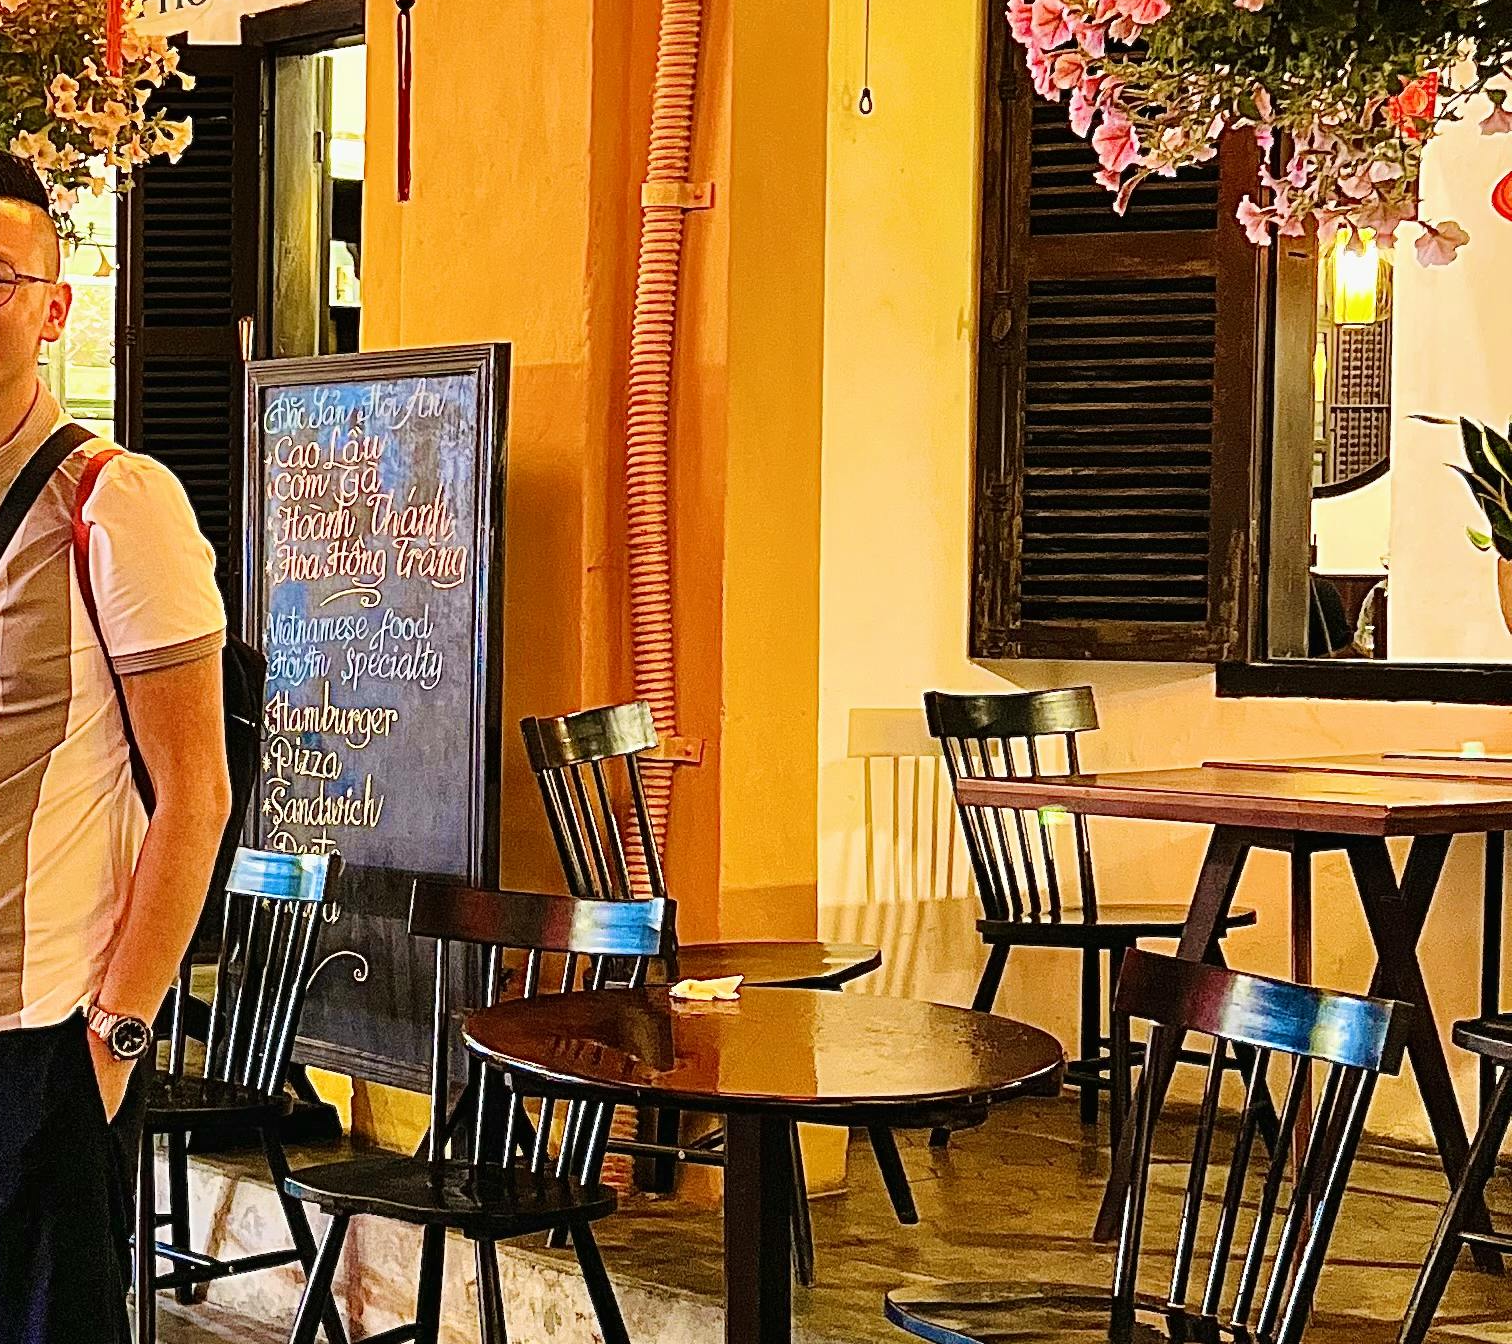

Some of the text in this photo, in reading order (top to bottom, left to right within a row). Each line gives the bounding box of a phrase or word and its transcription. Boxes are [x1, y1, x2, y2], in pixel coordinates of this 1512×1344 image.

[275, 436, 321, 468] Cao
[274, 544, 324, 586] Hoa
[370, 603, 434, 653] food
[264, 680, 399, 749] Hamburger
[266, 736, 343, 785] Pizza
[267, 774, 385, 838] Sandwich
